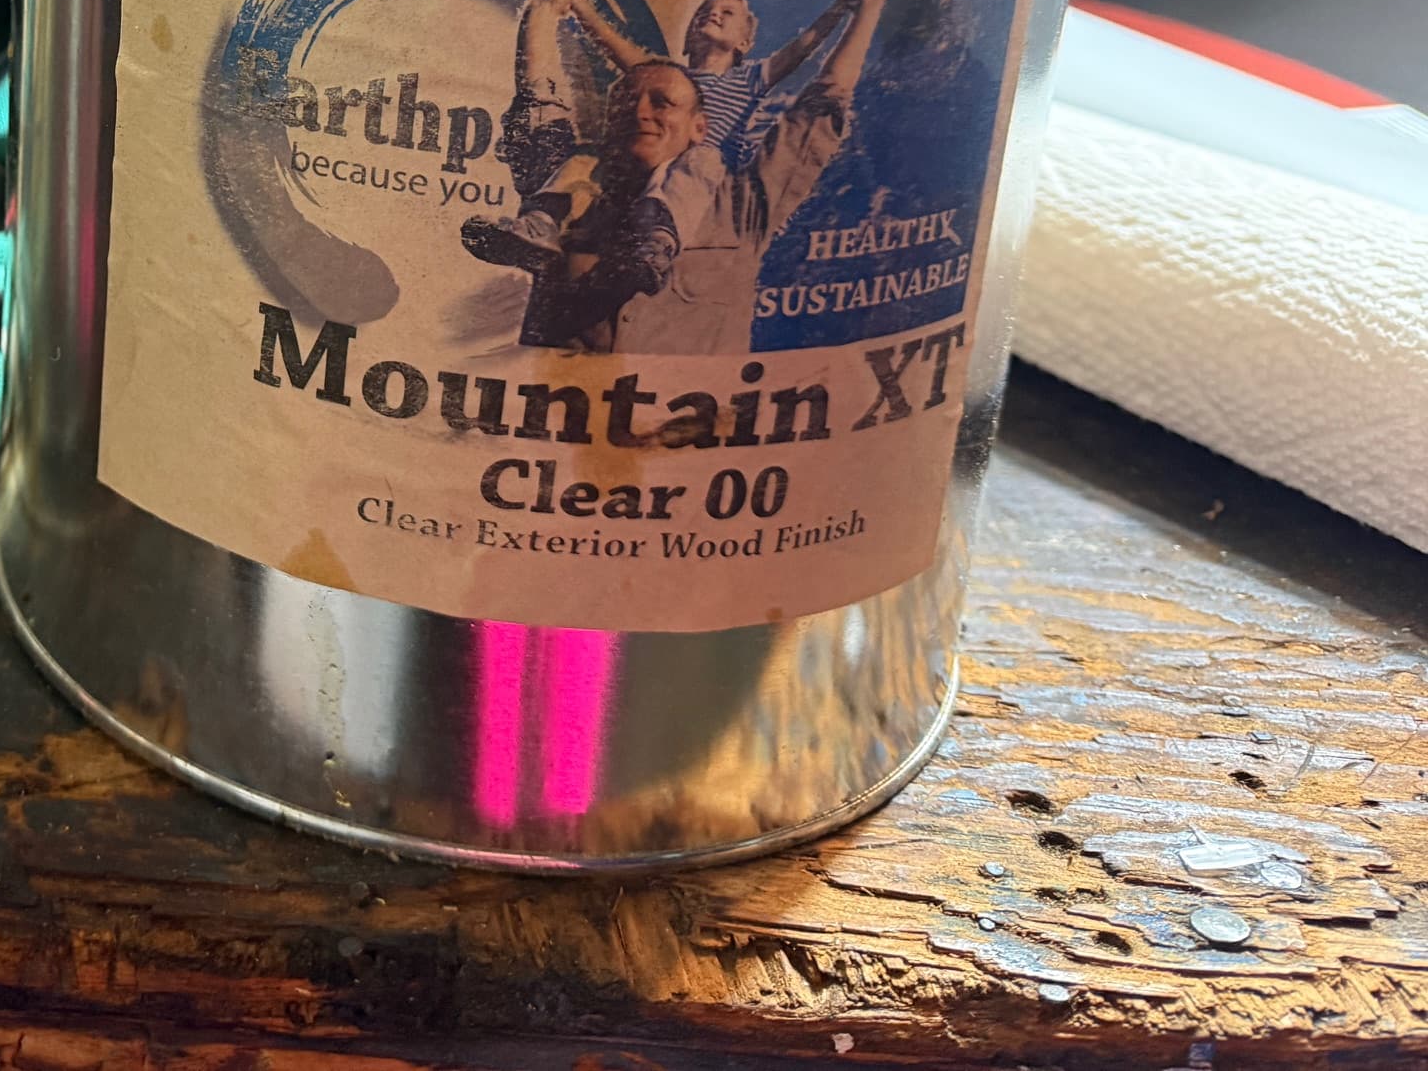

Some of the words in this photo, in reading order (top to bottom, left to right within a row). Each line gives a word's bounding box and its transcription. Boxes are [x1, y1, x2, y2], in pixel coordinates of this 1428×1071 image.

[290, 142, 428, 196] because
[440, 177, 504, 207] you
[756, 252, 970, 318] SUSTAINABLE
[253, 301, 831, 451] Mountain
[851, 320, 966, 432] XT
[480, 458, 688, 520] Clear
[705, 466, 791, 521] 00
[357, 496, 463, 543] Clear
[475, 519, 647, 559] Exterior
[661, 530, 763, 560] Wood
[773, 510, 867, 554] Finish
